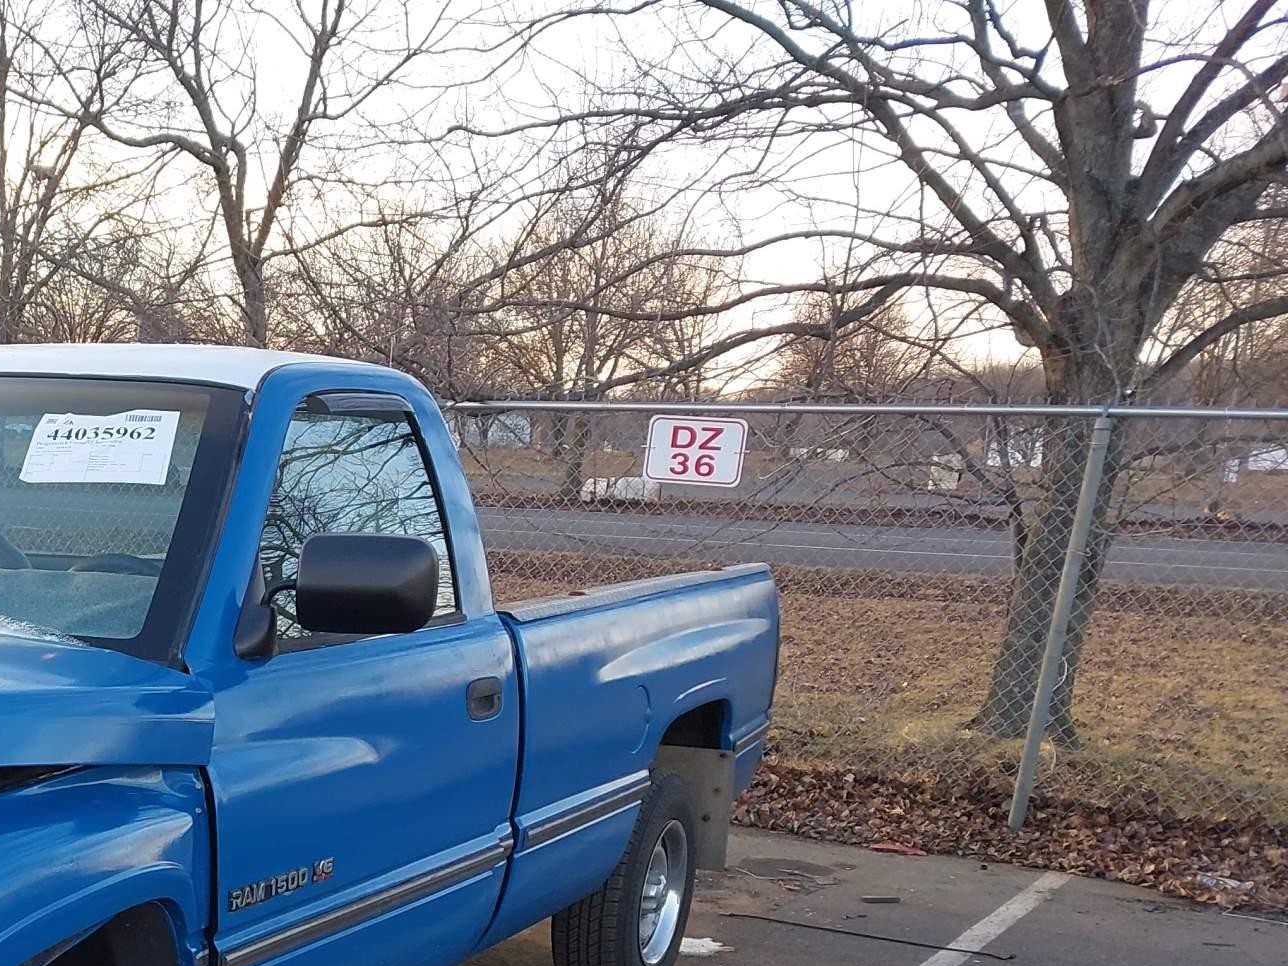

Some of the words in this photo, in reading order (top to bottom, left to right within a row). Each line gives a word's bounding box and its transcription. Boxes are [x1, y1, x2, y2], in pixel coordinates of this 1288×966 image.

[46, 426, 157, 441] 44035962
[670, 425, 725, 451] DZ
[669, 452, 716, 477] 36
[230, 882, 266, 912] RAM
[270, 867, 310, 897] 1500
